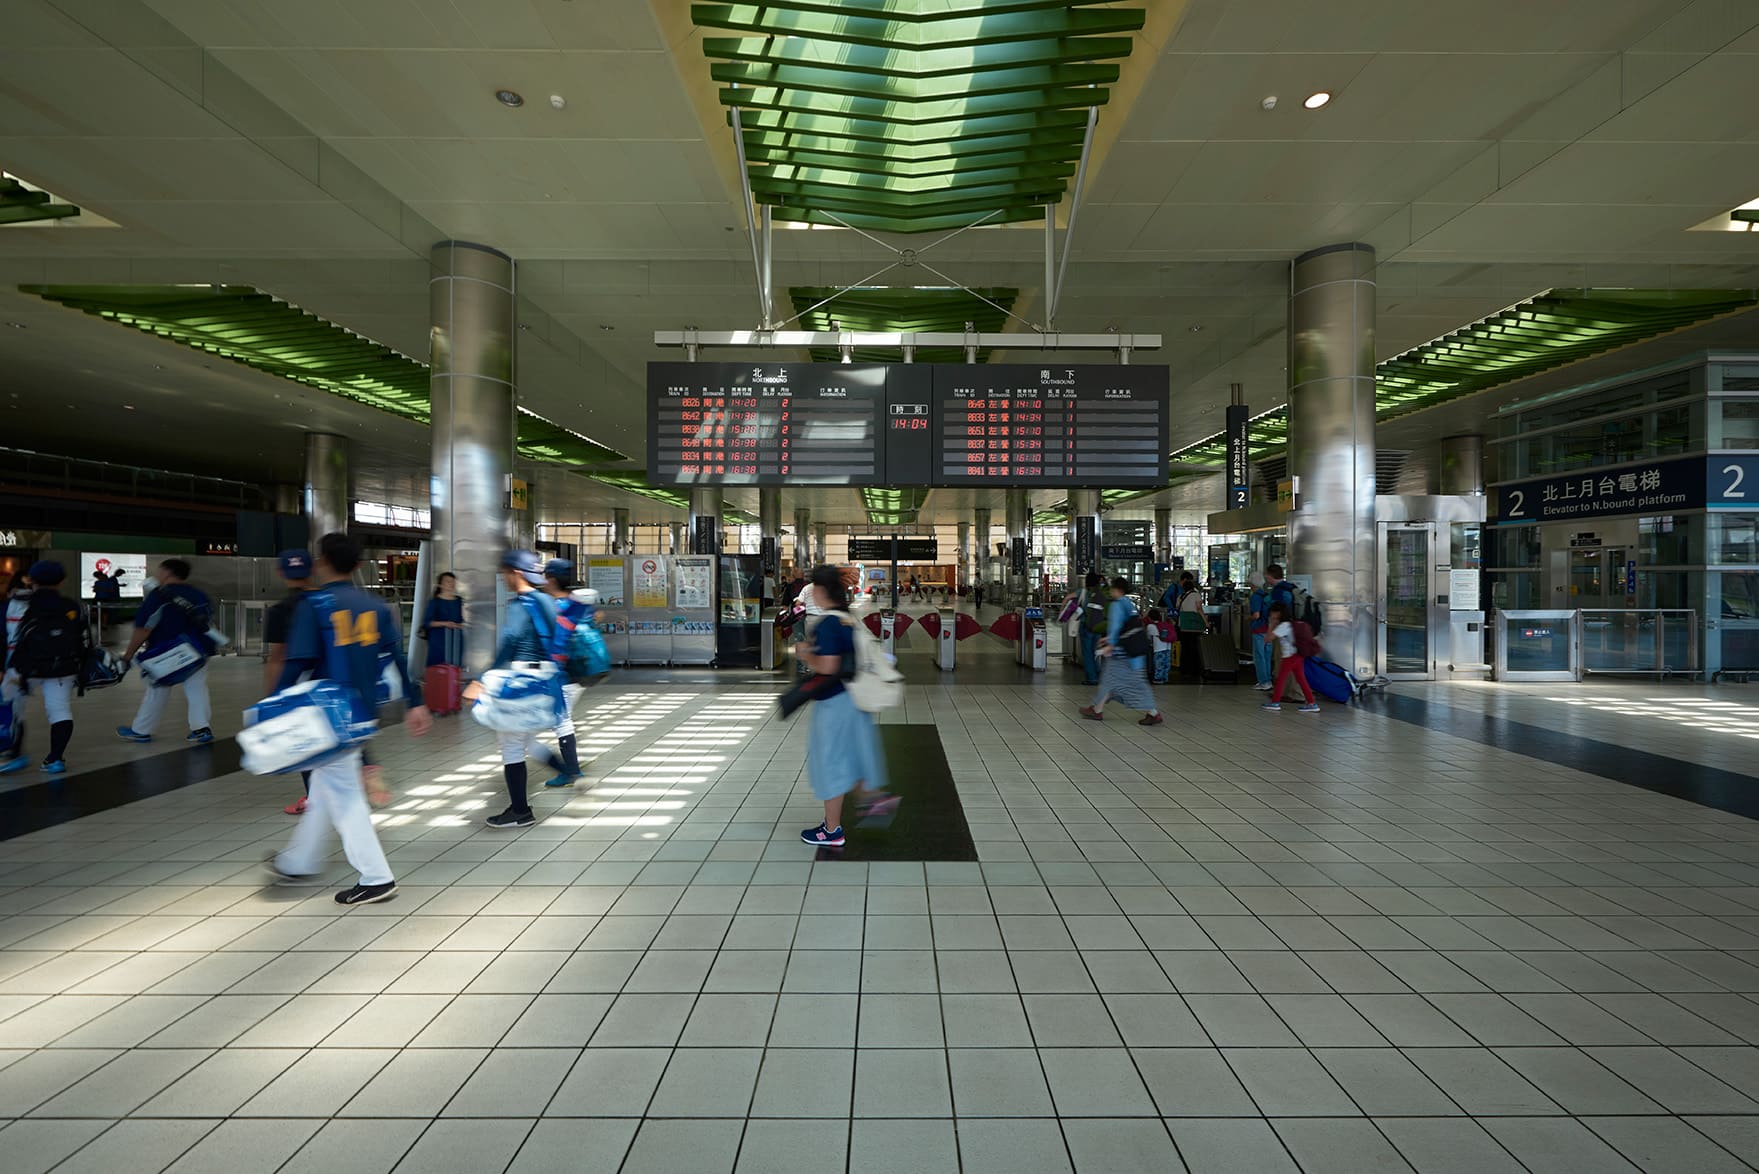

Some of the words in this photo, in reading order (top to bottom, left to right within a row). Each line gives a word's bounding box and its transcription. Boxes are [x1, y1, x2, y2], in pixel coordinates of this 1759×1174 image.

[753, 368, 787, 377] 北上
[1041, 370, 1075, 379] 南下
[731, 398, 757, 407] 14:20
[781, 398, 789, 407] 2
[1016, 400, 1041, 408] 14:10
[731, 411, 757, 420] 14:38
[781, 411, 789, 420] 2
[1016, 413, 1041, 422] 14:34
[895, 419, 927, 429] 14:04
[781, 425, 789, 434] 2
[1016, 426, 1041, 435] 15:10
[781, 438, 789, 447] 2
[1016, 440, 1041, 448] 15:34
[731, 452, 757, 461] 16:20
[781, 452, 789, 461] 2
[1016, 453, 1041, 462] 16:10
[731, 465, 757, 474] 16:38
[781, 465, 789, 474] 2
[1016, 466, 1041, 475] 16:34
[1542, 469, 1661, 502] 北上月台電梯
[1722, 464, 1745, 498] 2
[1238, 491, 1245, 502] 2
[1508, 490, 1525, 517] 2
[1543, 504, 1578, 516] Elevator
[1580, 503, 1590, 512] to
[1592, 498, 1635, 510] N.bound
[1638, 492, 1686, 509] platform
[329, 610, 381, 647] 14
